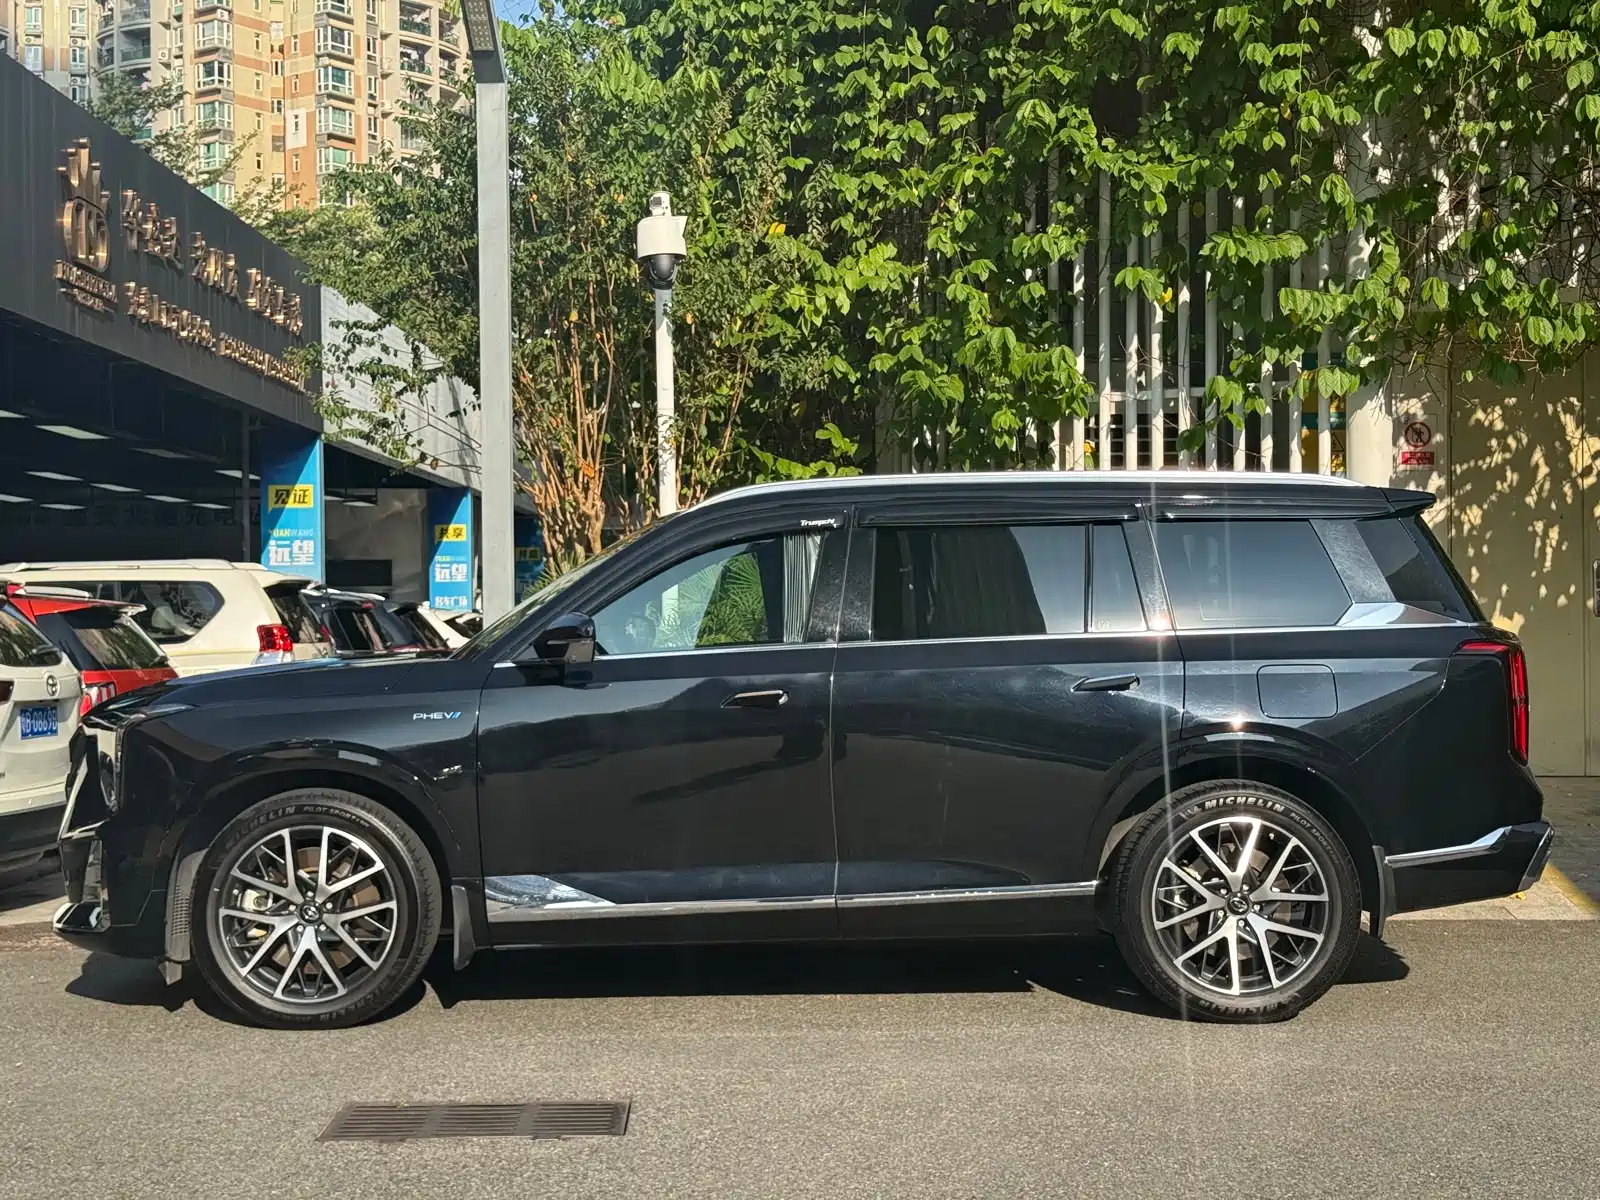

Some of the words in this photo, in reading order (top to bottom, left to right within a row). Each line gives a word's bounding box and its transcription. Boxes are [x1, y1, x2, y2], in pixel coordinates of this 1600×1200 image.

[274, 489, 309, 504] 见证
[439, 527, 464, 539] 共享
[269, 539, 315, 566] 远望
[435, 563, 468, 583] 远望
[1204, 796, 1286, 813] MICHELIN
[1289, 812, 1312, 828] PILOT
